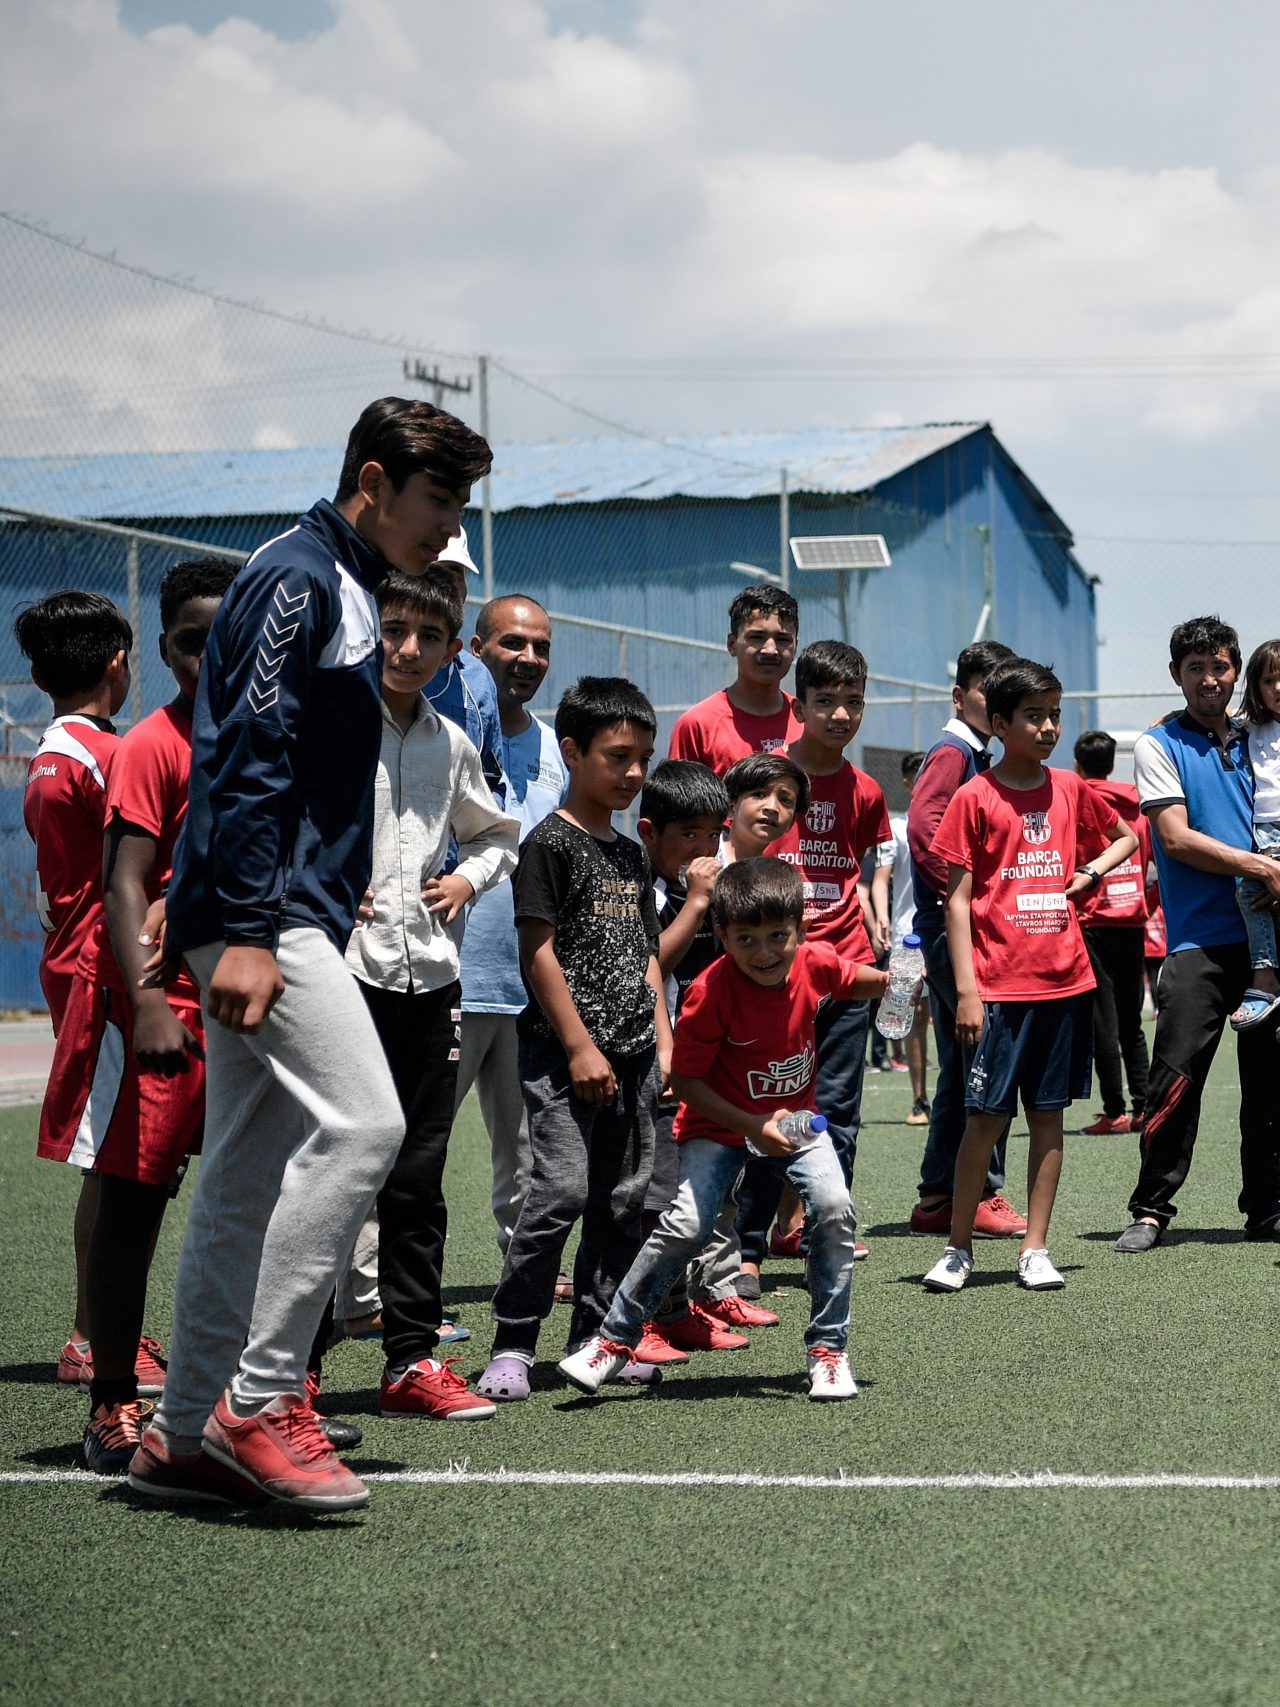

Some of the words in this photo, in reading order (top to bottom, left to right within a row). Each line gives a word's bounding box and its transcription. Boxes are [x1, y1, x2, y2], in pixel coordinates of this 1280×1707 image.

[799, 839, 838, 854] BARÇA
[1017, 850, 1062, 865] BARÇA
[758, 1064, 812, 1094] TINE
